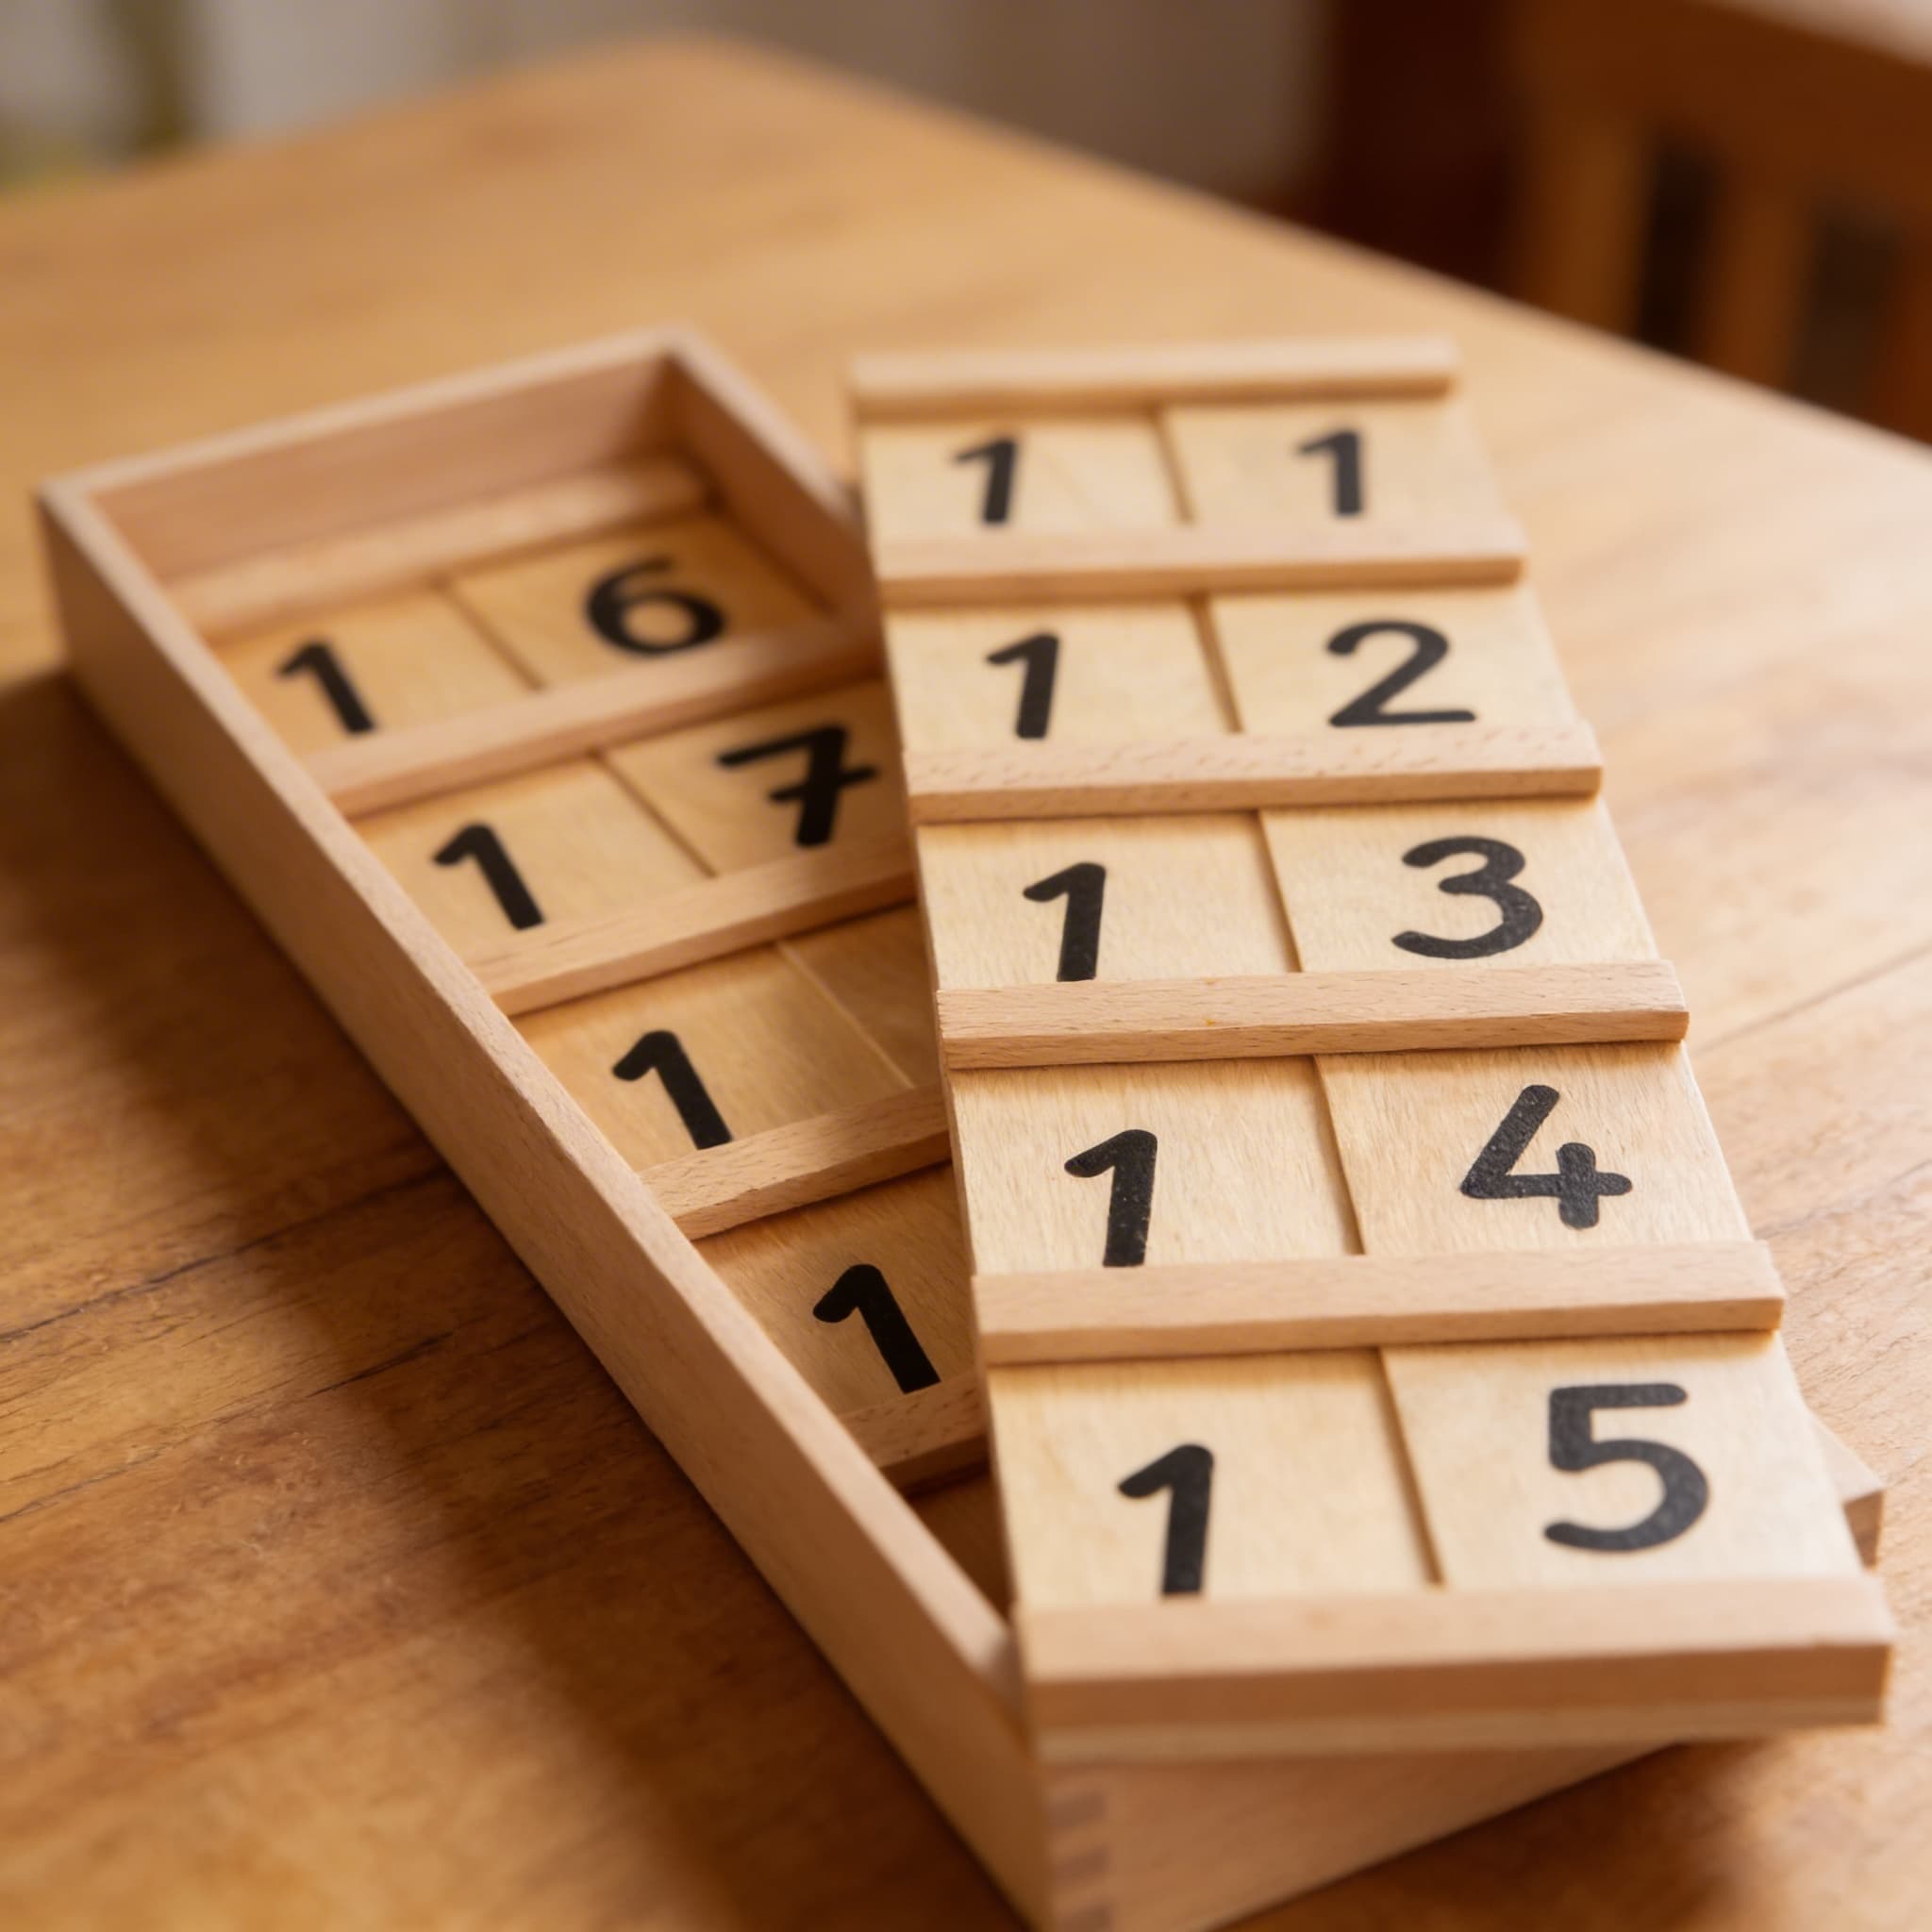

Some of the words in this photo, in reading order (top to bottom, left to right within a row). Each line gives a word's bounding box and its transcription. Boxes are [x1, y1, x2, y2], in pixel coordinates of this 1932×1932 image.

[956, 434, 1018, 525] 1
[1299, 427, 1362, 517] 1
[275, 639, 377, 737] 1
[584, 557, 726, 658] 6
[987, 631, 1059, 740] 1
[1324, 619, 1475, 728] 2
[433, 823, 544, 930] 1
[717, 722, 879, 849] 7
[1023, 862, 1107, 982] 1
[1392, 836, 1543, 960] 3
[612, 1029, 733, 1150] 1
[1064, 1128, 1158, 1267] 1
[1460, 1085, 1632, 1228] 4
[812, 1263, 941, 1394] 1
[1117, 1442, 1215, 1596] 1
[1544, 1383, 1709, 1552] 5
